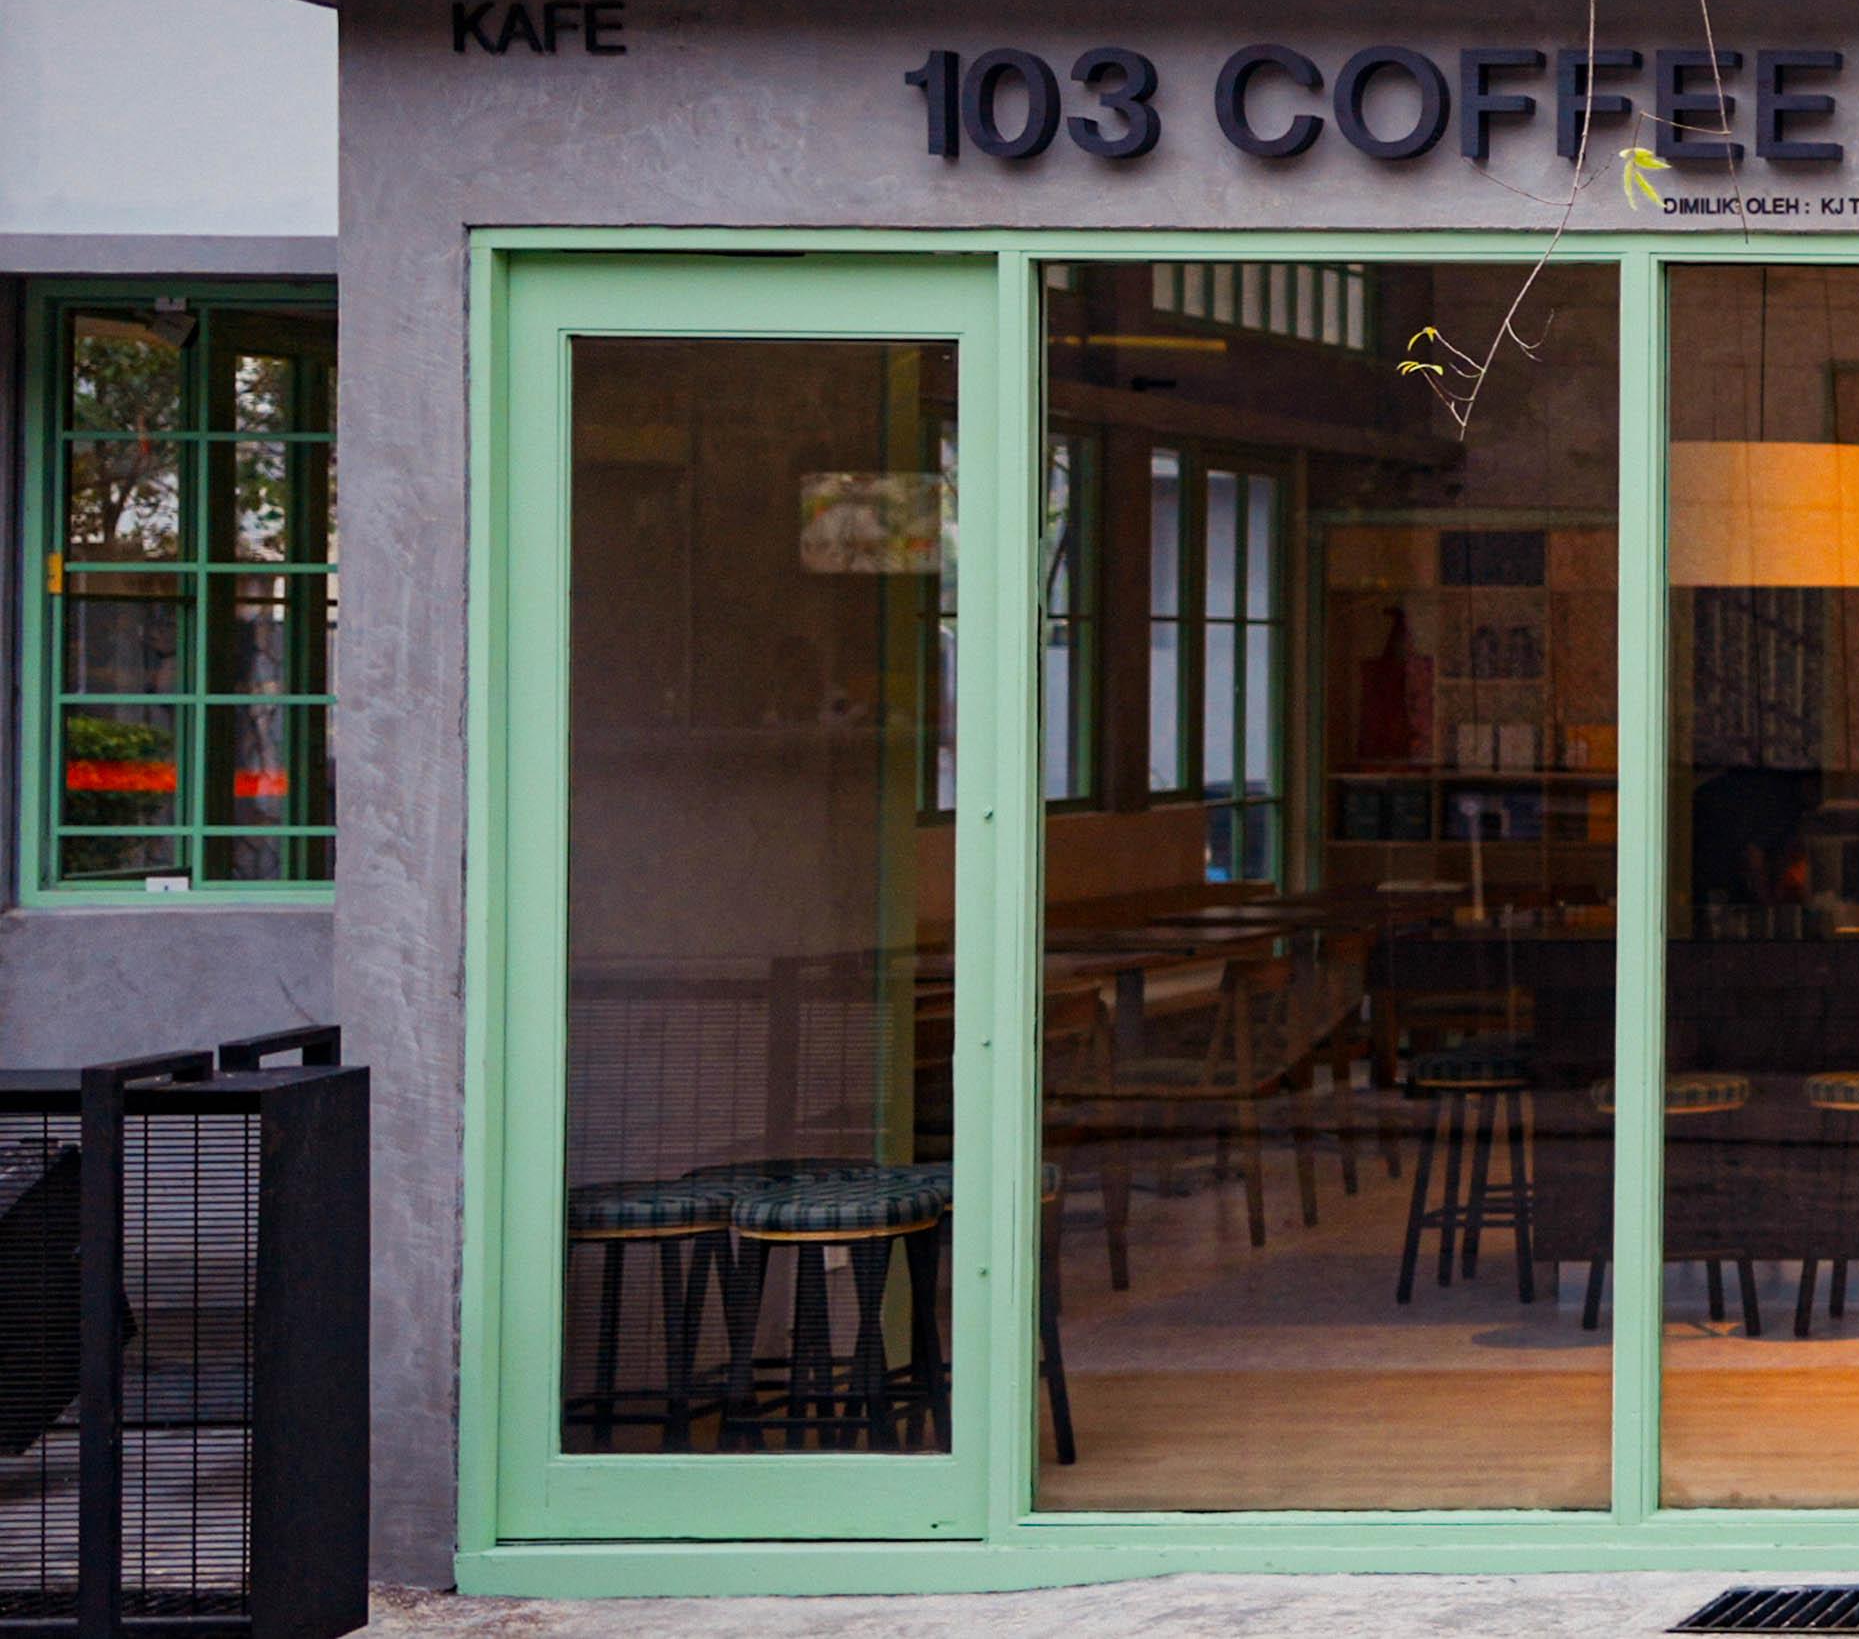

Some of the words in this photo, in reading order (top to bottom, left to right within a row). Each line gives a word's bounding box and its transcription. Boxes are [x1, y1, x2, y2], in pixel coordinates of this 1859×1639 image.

[451, 0, 627, 56] KAFE
[904, 47, 1162, 161] 103
[1214, 42, 1845, 163] COFFEE
[1746, 196, 1800, 216] OLEH
[1820, 196, 1845, 216] KJ
